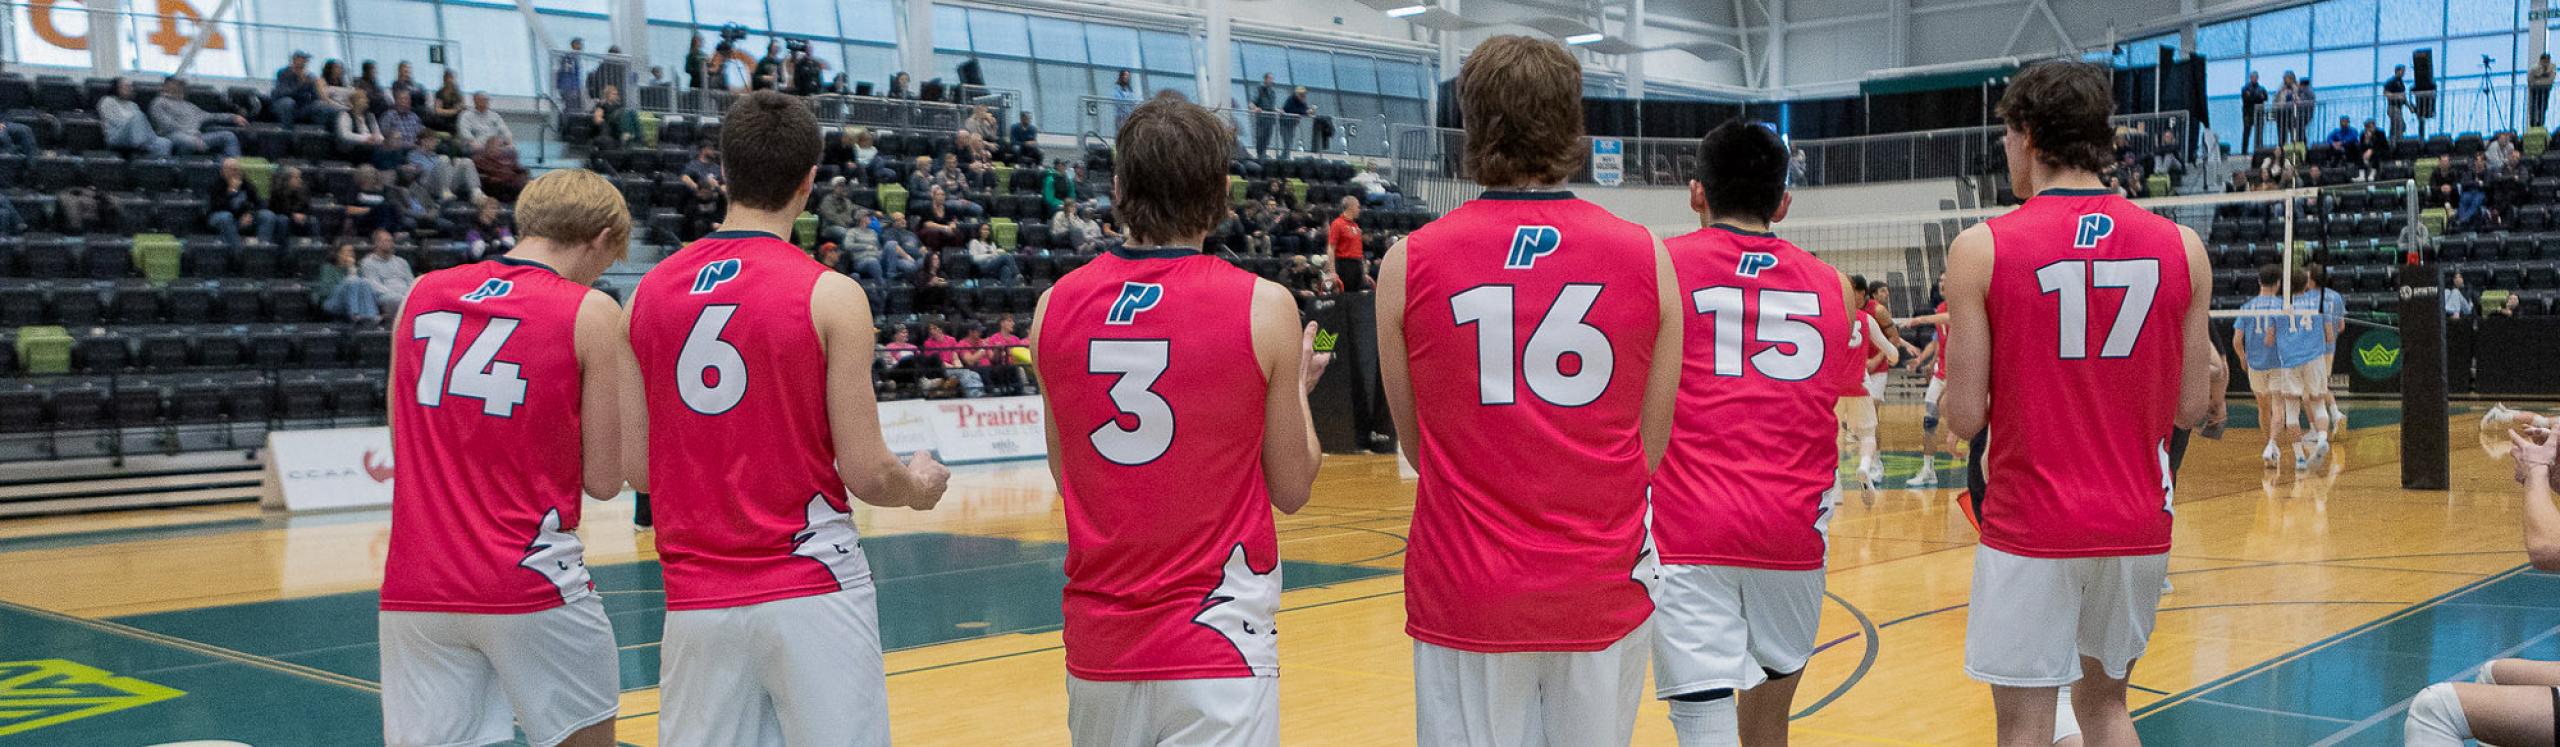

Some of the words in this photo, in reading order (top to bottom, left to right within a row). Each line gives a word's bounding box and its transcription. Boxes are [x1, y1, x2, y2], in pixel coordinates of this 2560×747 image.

[675, 303, 749, 416] 6
[1448, 282, 1615, 408] 16
[1690, 284, 1826, 382] 15
[2034, 257, 2161, 361] 17
[413, 310, 529, 419] 14
[957, 403, 1039, 429] Prairie
[1088, 338, 1175, 467] 3
